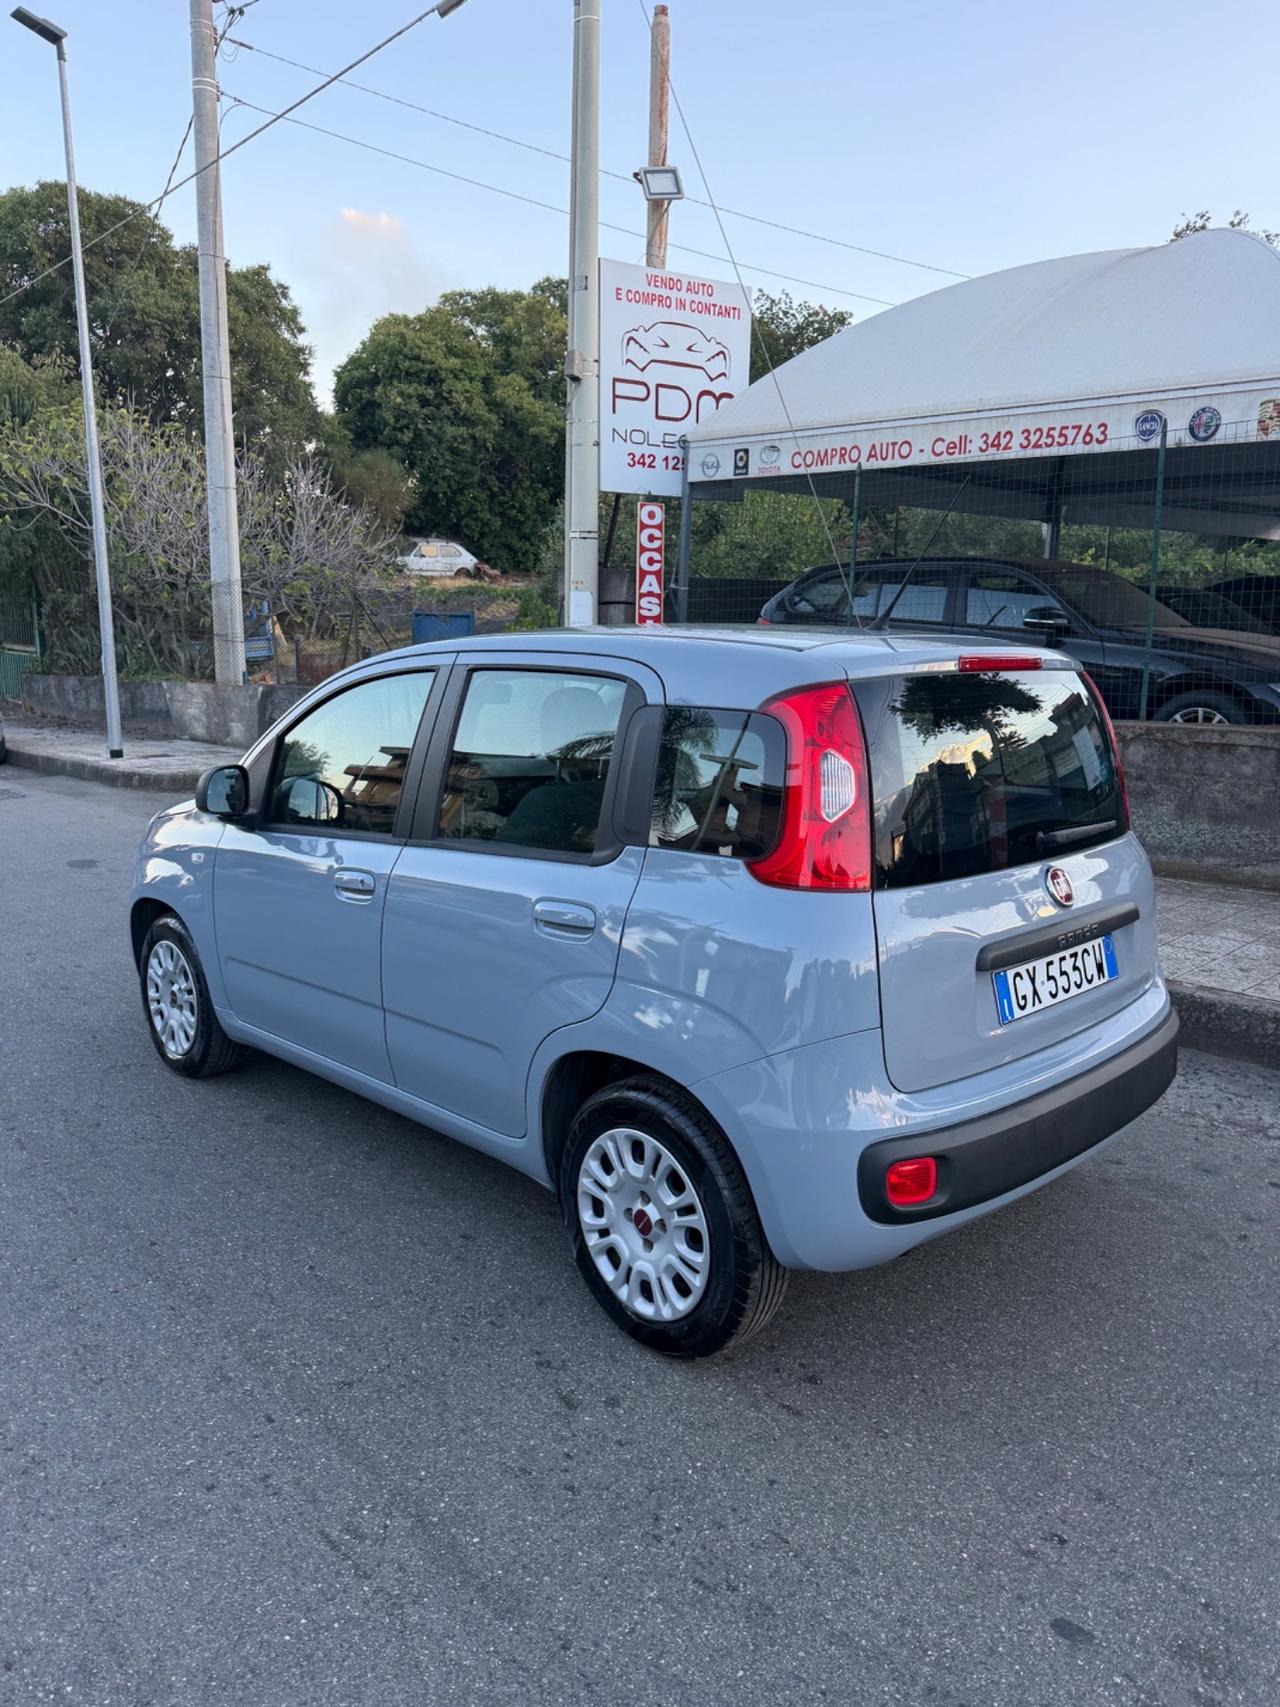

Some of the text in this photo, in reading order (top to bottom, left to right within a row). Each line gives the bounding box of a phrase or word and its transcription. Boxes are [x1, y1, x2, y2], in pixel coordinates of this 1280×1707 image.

[645, 272, 714, 298] VENDO AUTO
[615, 287, 741, 320] E COMPRO IN CONTANTI
[627, 452, 656, 469] 342
[791, 444, 862, 469] COMPRO
[866, 440, 913, 463] AUTO
[931, 434, 973, 457] Cell:
[978, 430, 1014, 453] 342
[1019, 422, 1108, 449] 3255763
[639, 505, 663, 624] OCCAS
